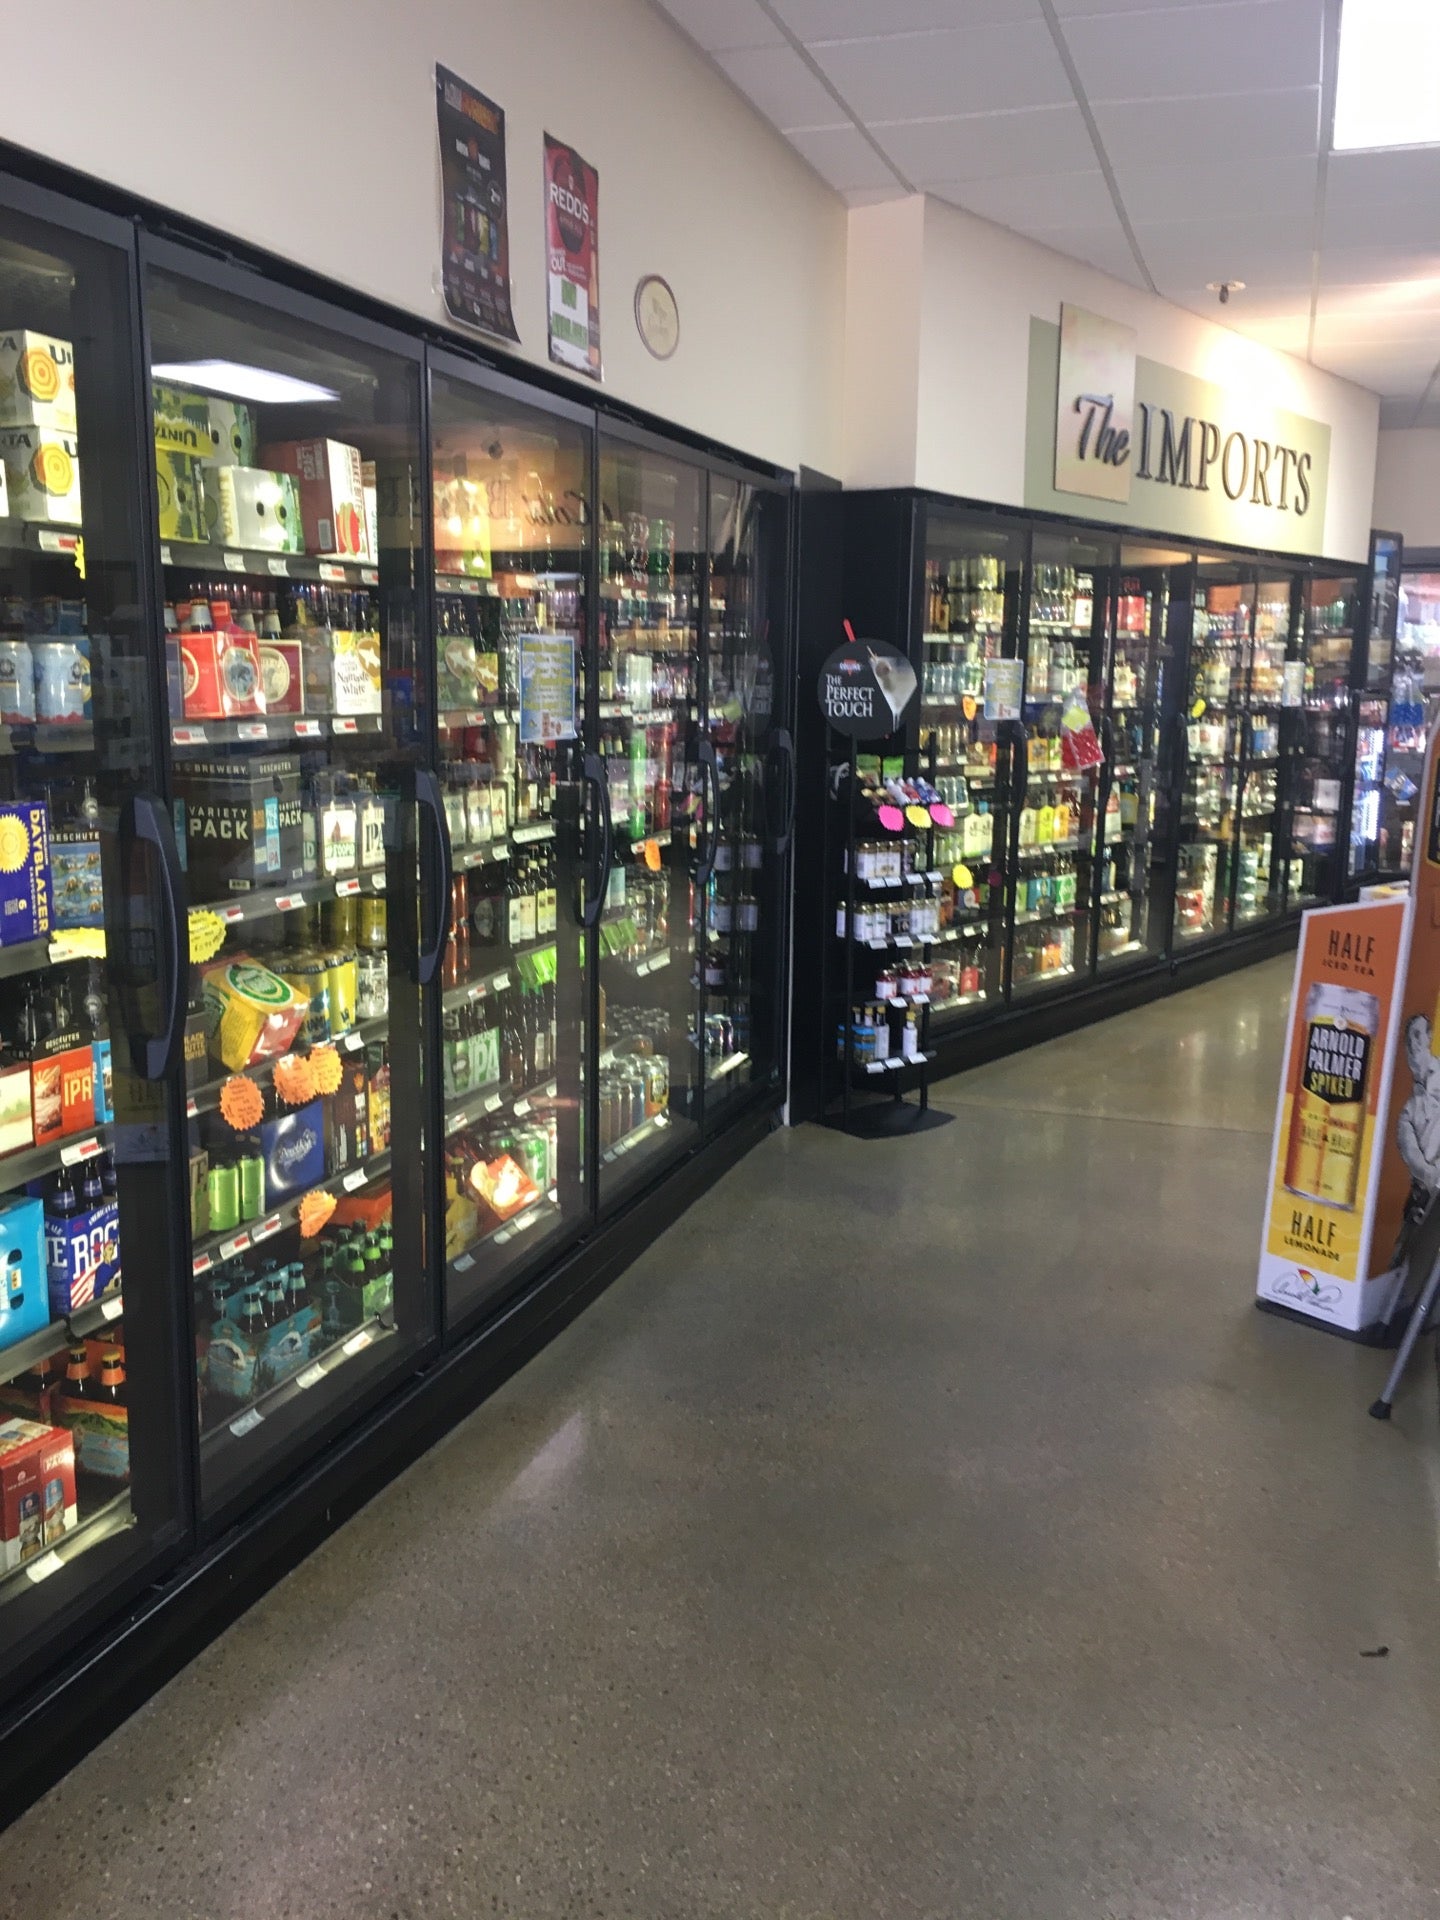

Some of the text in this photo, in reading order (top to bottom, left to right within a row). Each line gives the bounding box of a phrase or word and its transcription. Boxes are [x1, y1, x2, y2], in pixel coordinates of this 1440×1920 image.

[1073, 393, 1312, 517] The IMPORTS
[826, 673, 842, 687] THE
[826, 684, 875, 702] PERFECT
[825, 698, 873, 718] TOUCH
[188, 805, 248, 819] VARIETY
[279, 810, 302, 829] PACK
[189, 818, 250, 841] PACK
[29, 808, 49, 933] DAYBLAZER
[1328, 929, 1376, 964] HALF
[1322, 958, 1375, 977] ICED TEA
[1310, 1026, 1366, 1060] ARNOLD
[1308, 1046, 1363, 1082] PALMER
[63, 1075, 93, 1107] IPA
[1310, 1070, 1355, 1098] SPIKED
[1291, 1209, 1337, 1248] HALF
[1283, 1235, 1340, 1262] LEMONADE
